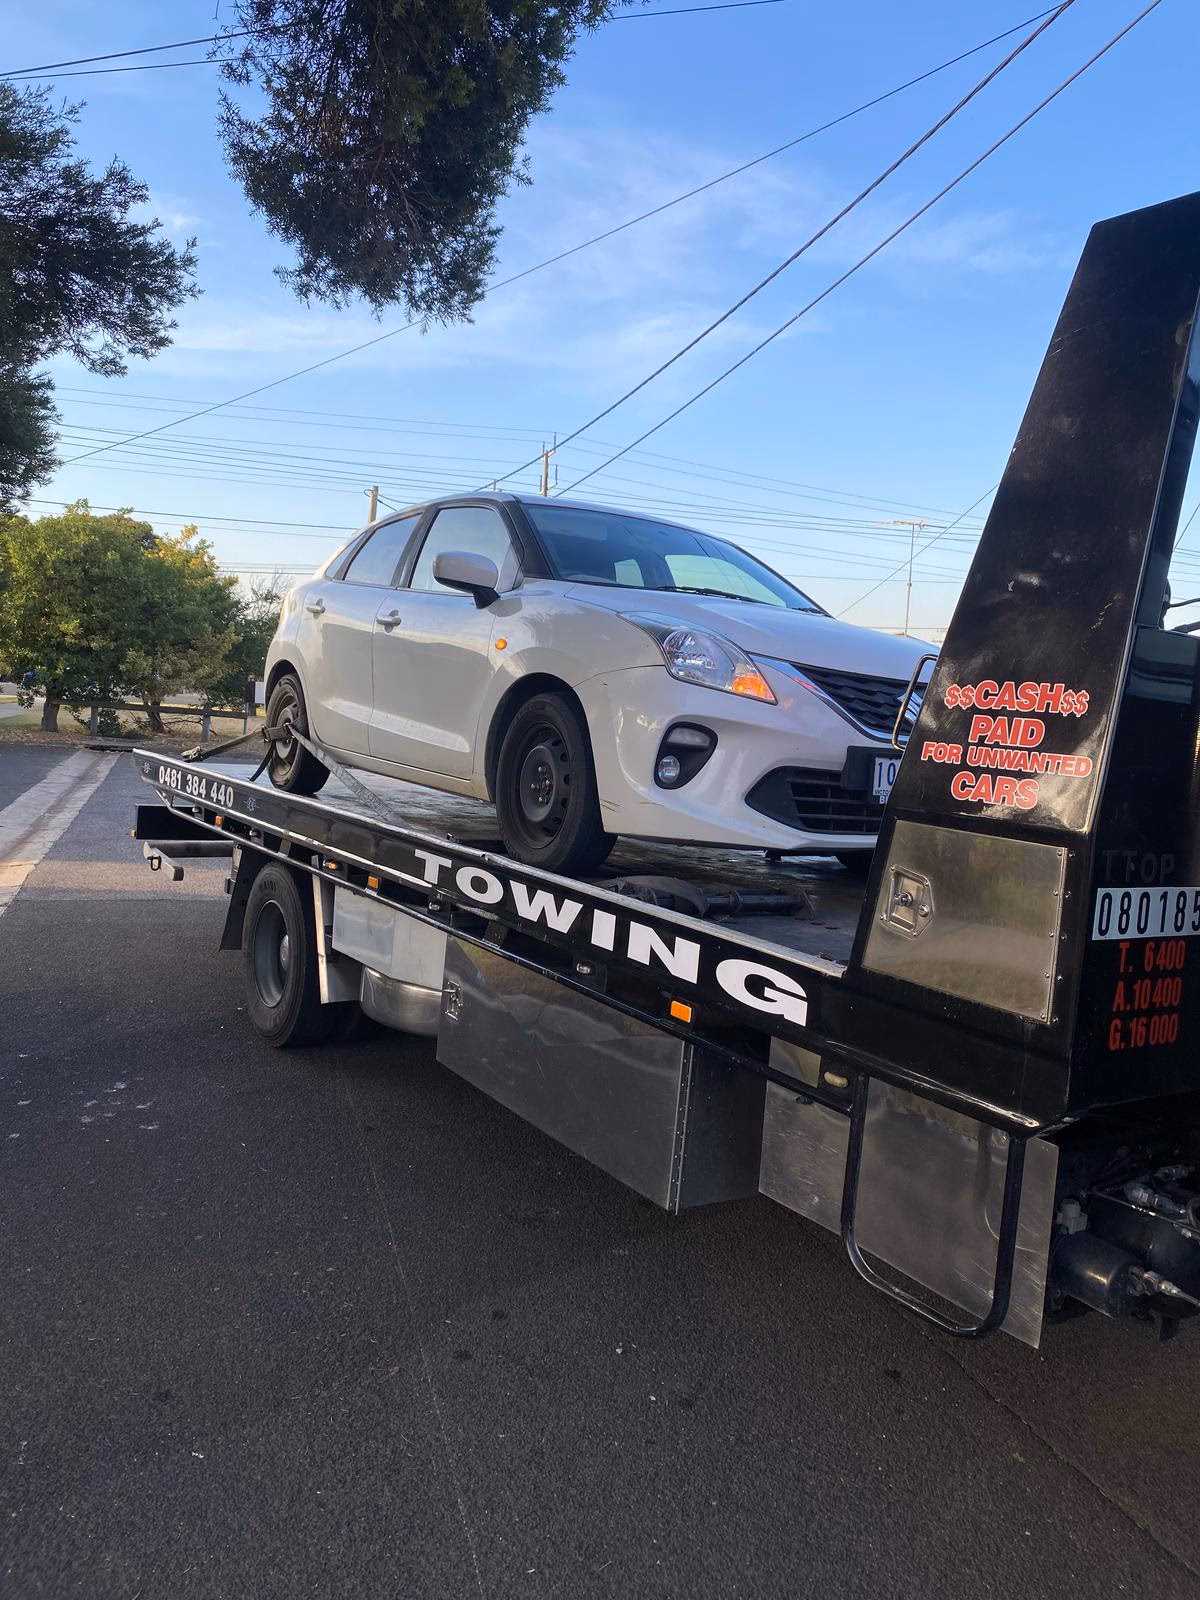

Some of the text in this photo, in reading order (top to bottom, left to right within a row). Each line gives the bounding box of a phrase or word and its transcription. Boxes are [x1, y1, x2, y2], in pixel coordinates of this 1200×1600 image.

[944, 679, 1090, 717] $$CASH$$
[968, 715, 1045, 748] PAID
[921, 741, 1093, 778] FOR UNWANTED
[159, 766, 233, 807] 0481 384 440
[950, 771, 1040, 810] CARS
[412, 848, 809, 1027] TOWING
